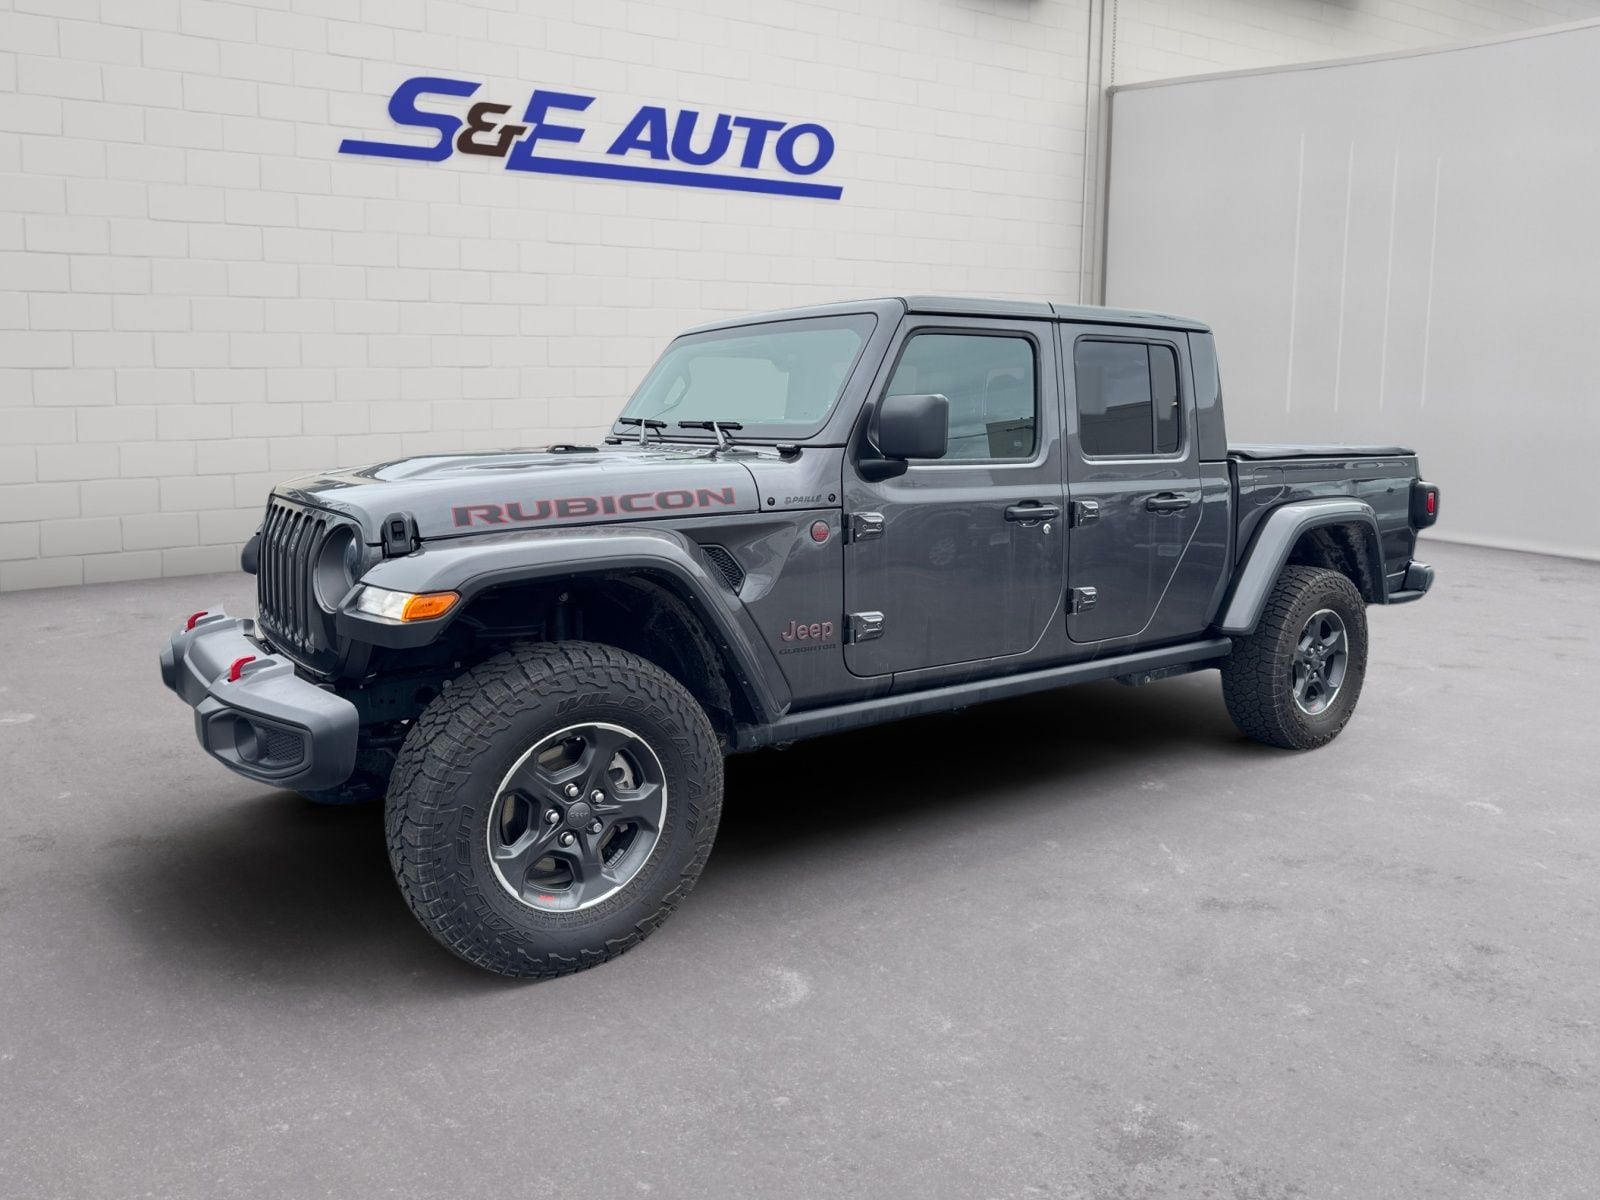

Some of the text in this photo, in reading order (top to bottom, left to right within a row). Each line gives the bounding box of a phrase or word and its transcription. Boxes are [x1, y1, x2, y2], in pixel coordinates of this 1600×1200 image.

[338, 76, 836, 176] S&E AUTO
[451, 487, 737, 528] RUBICON
[781, 620, 833, 642] Jeep
[779, 643, 836, 656] GLADIATOR
